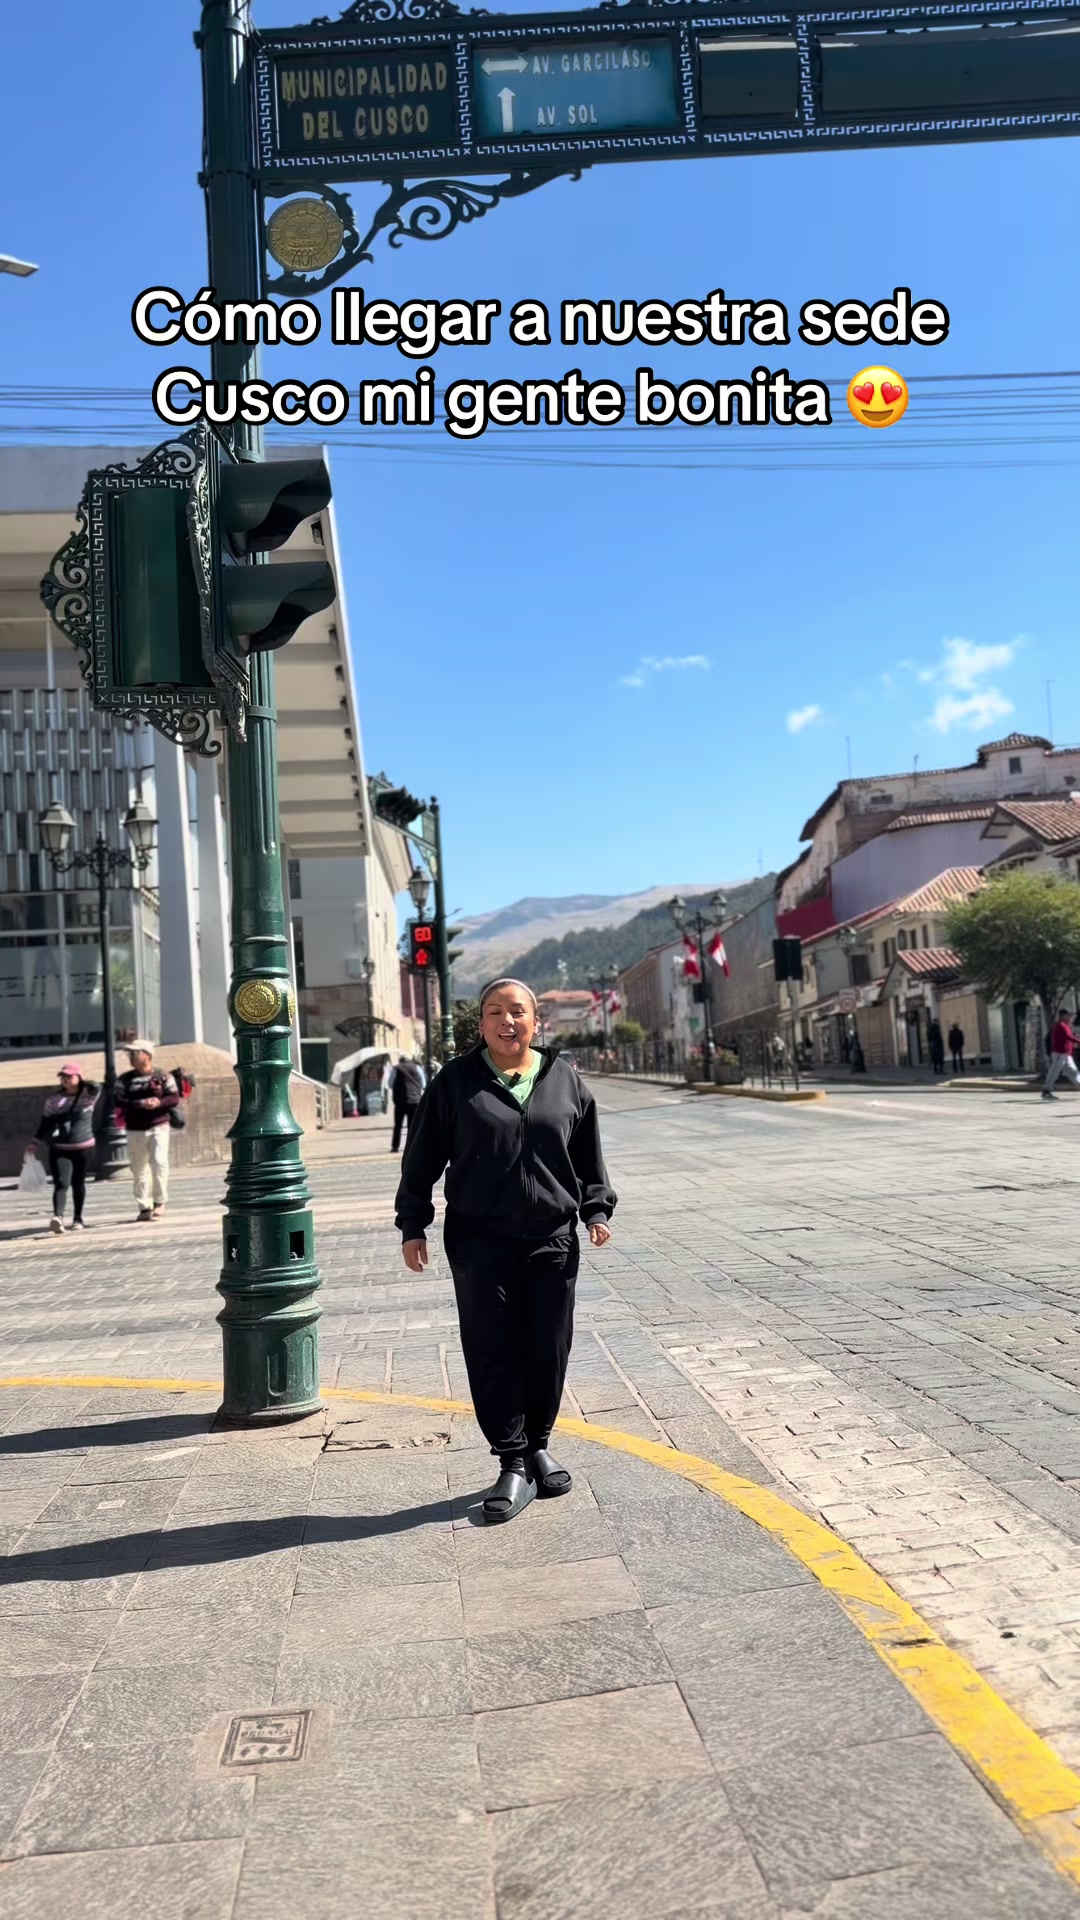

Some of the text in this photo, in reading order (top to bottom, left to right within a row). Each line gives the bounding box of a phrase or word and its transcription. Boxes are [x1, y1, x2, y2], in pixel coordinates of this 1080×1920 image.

[532, 48, 651, 75] AV. GARCILASO
[281, 62, 447, 101] MUNICIPALIDAD
[302, 104, 429, 141] DEL CUSCO
[537, 104, 598, 127] AV. SOL
